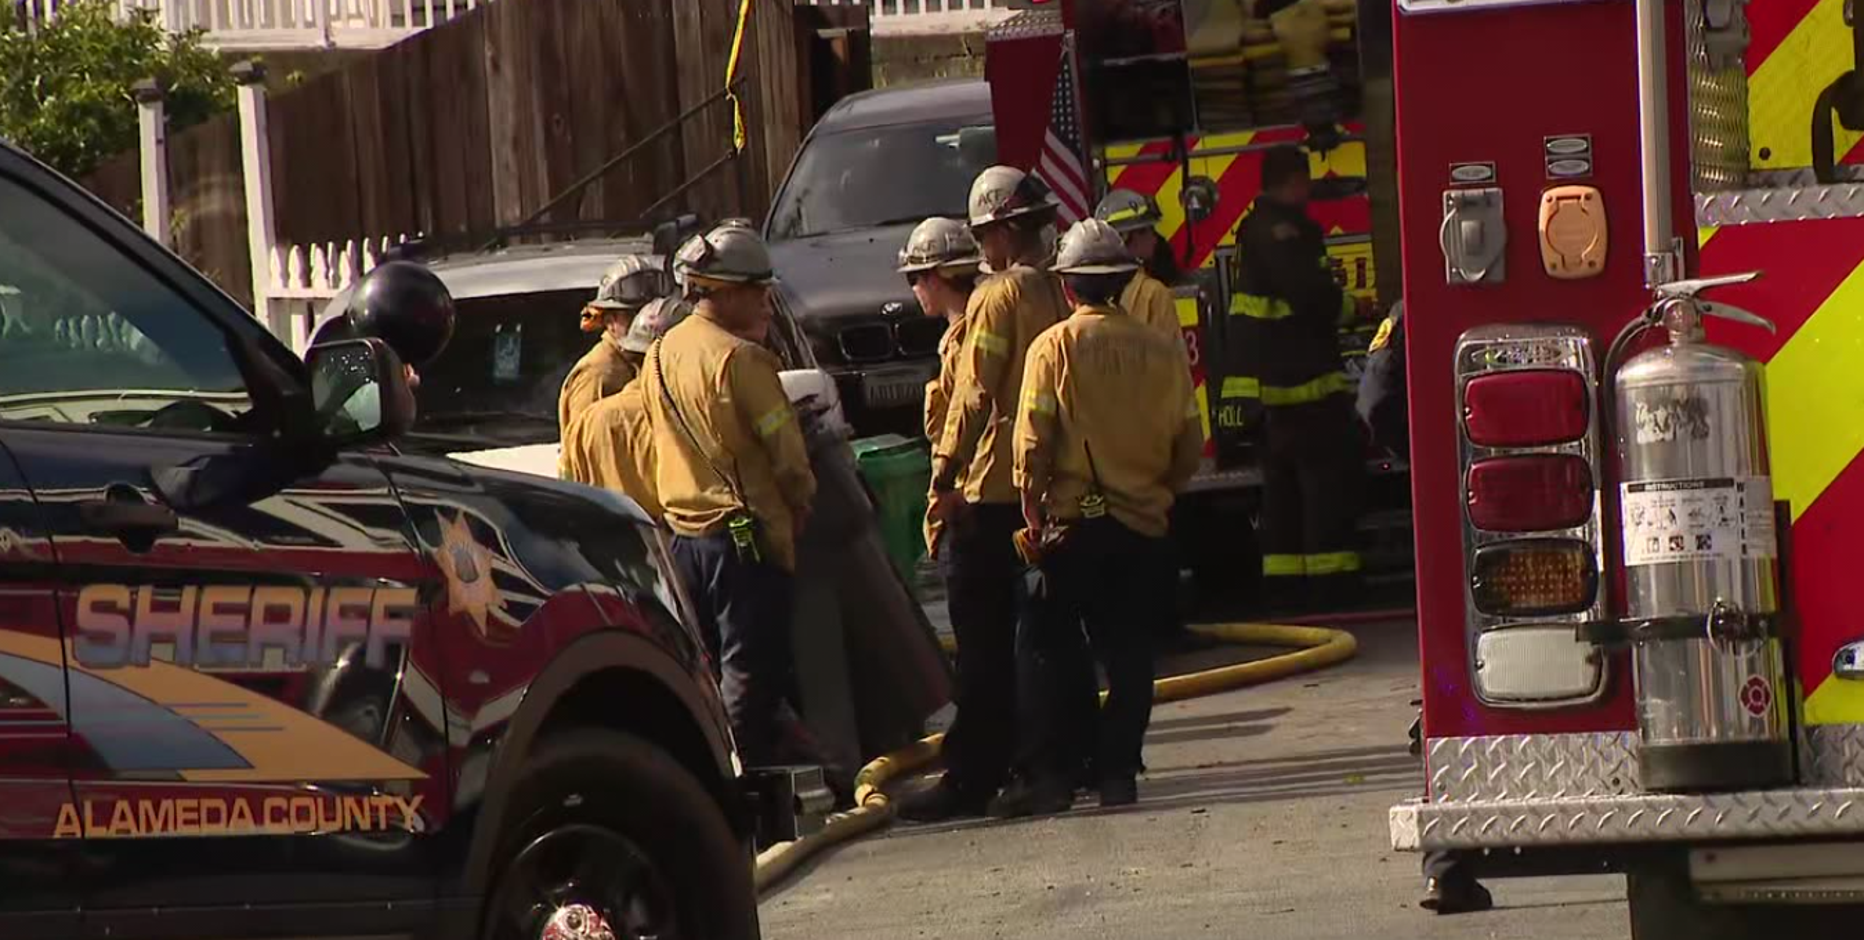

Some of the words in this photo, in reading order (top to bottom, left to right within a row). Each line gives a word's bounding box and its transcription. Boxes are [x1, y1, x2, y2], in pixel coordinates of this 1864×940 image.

[1185, 330, 1200, 366] 3
[72, 583, 418, 671] SHERIFF
[54, 797, 258, 838] ALAMEDA
[263, 794, 424, 833] COUNTY
